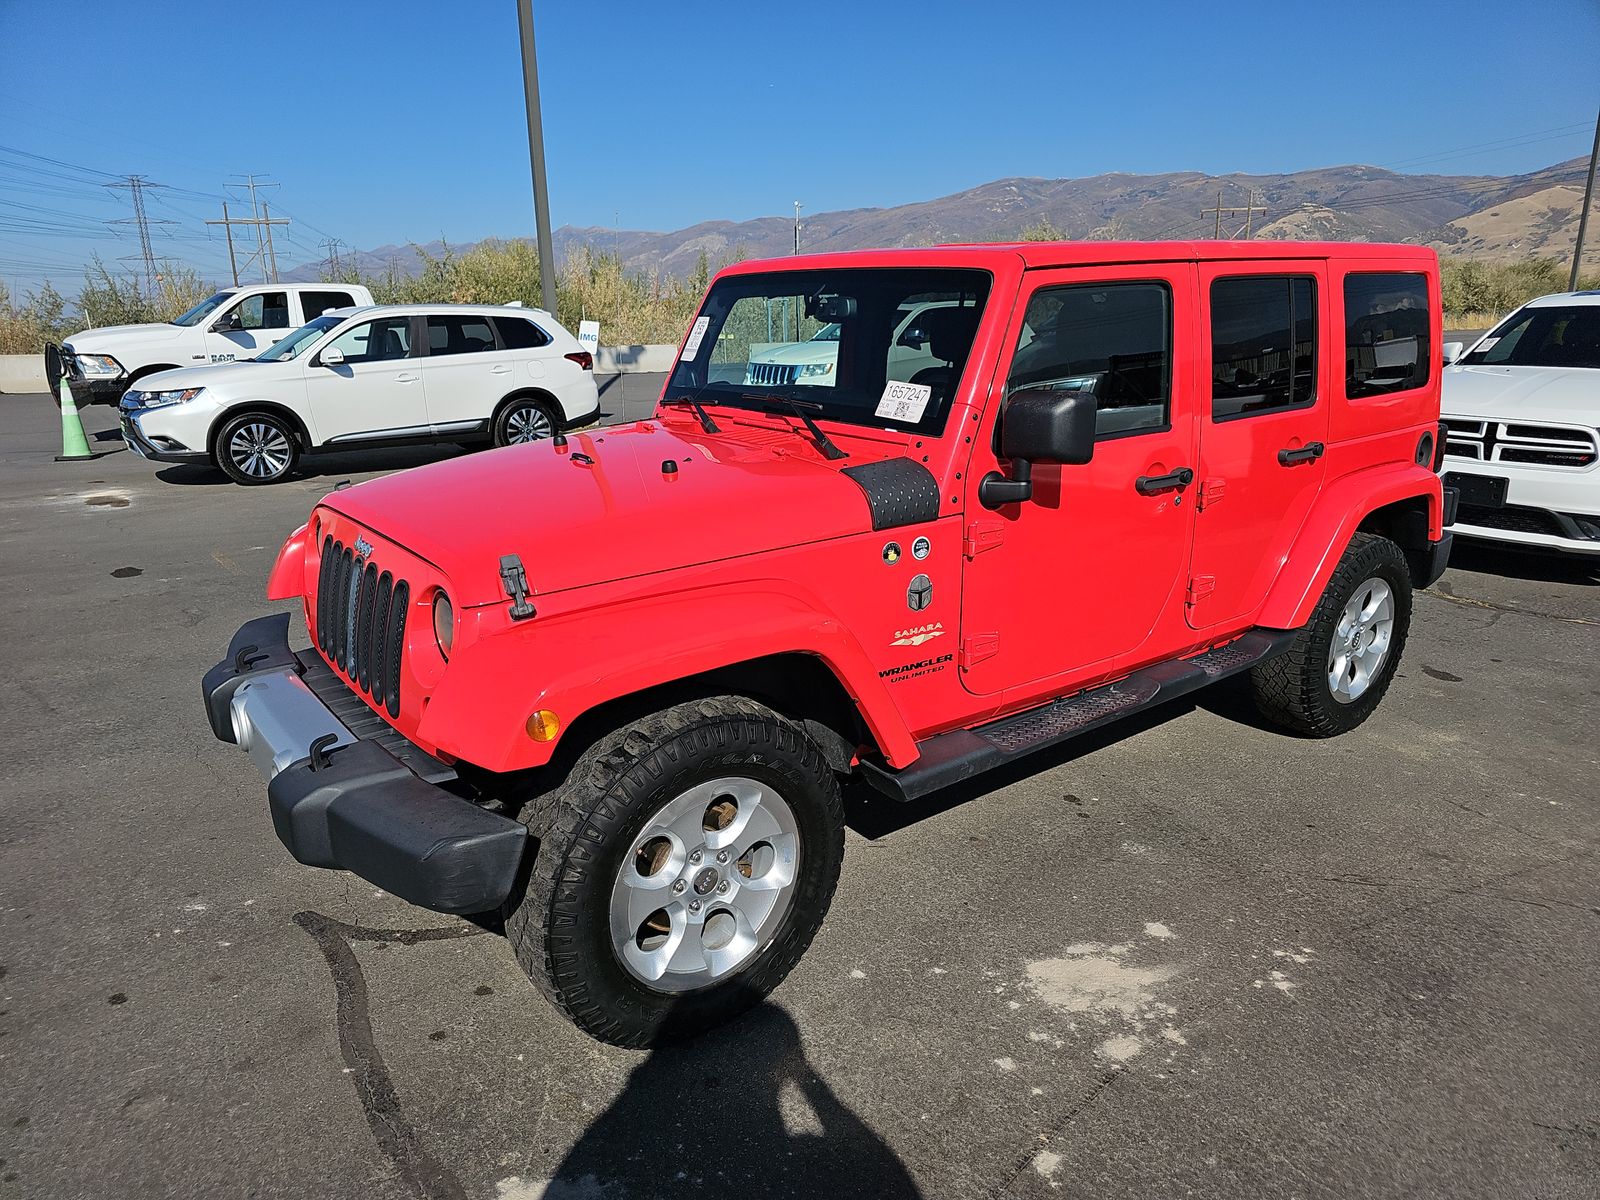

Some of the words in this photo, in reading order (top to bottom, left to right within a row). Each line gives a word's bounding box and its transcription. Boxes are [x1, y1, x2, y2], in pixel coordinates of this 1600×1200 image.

[580, 333, 598, 341] IMG
[888, 384, 928, 402] 1657247
[894, 622, 943, 639] SAHARA
[878, 653, 953, 678] WRANGLER
[891, 665, 945, 683] UNLIMITED
